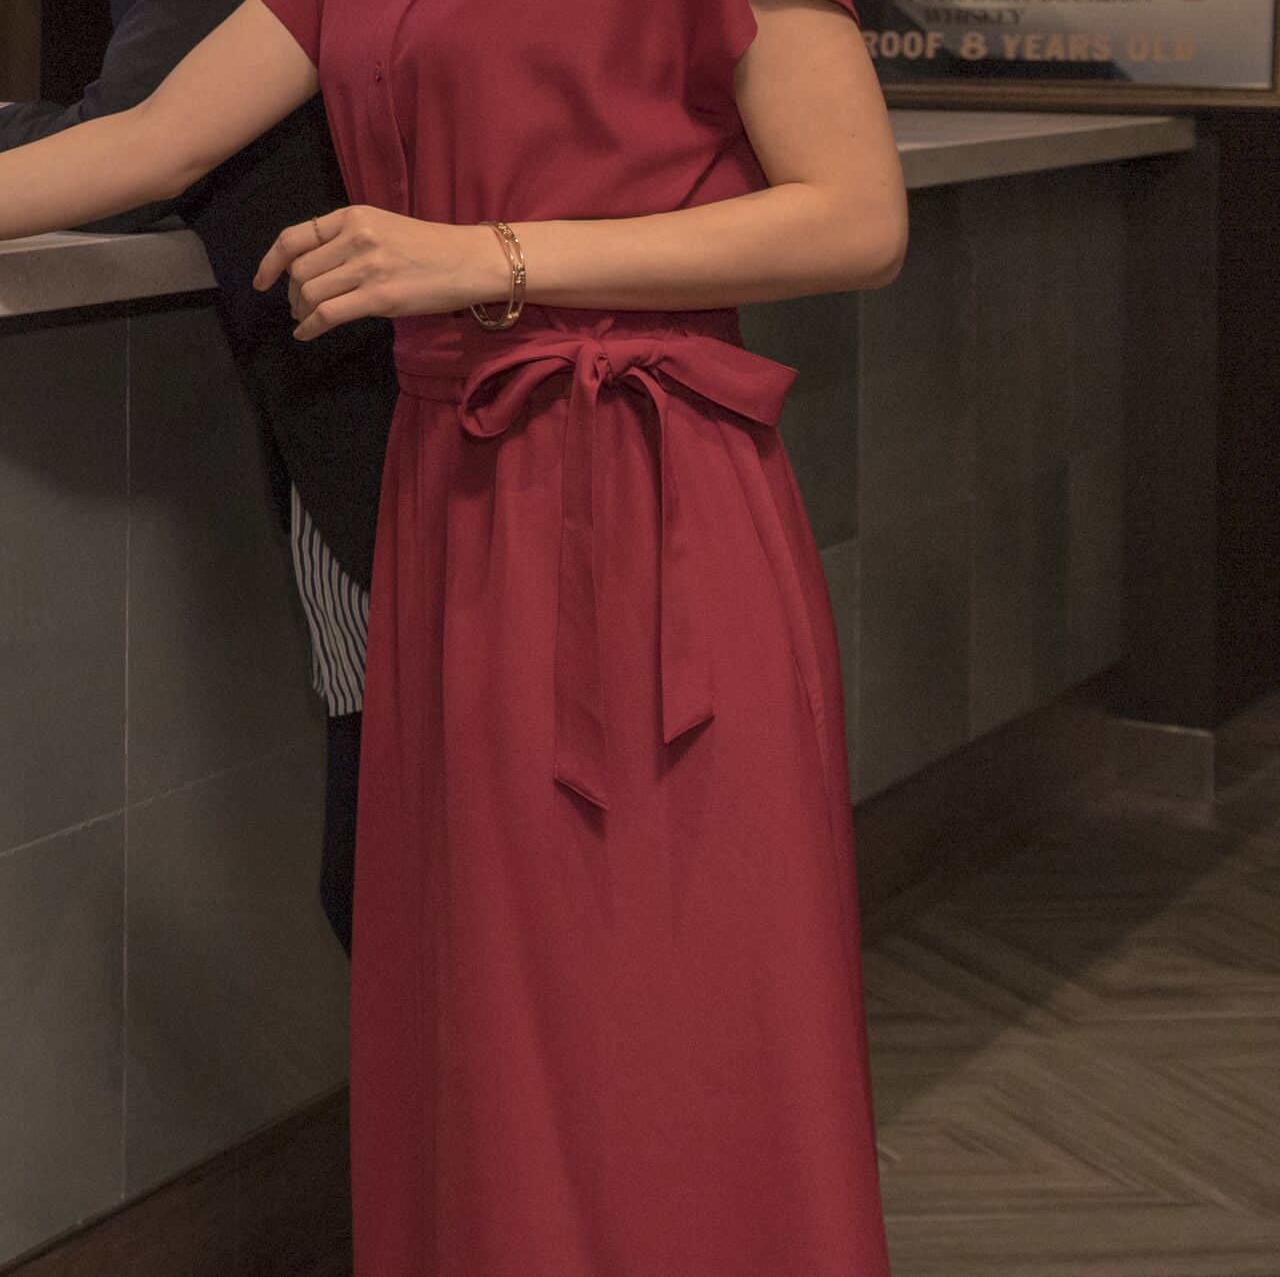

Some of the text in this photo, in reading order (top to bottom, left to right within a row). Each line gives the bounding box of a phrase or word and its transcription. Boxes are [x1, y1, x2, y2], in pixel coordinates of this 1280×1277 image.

[863, 31, 1198, 62] ROOF 8 YEARS OLD
